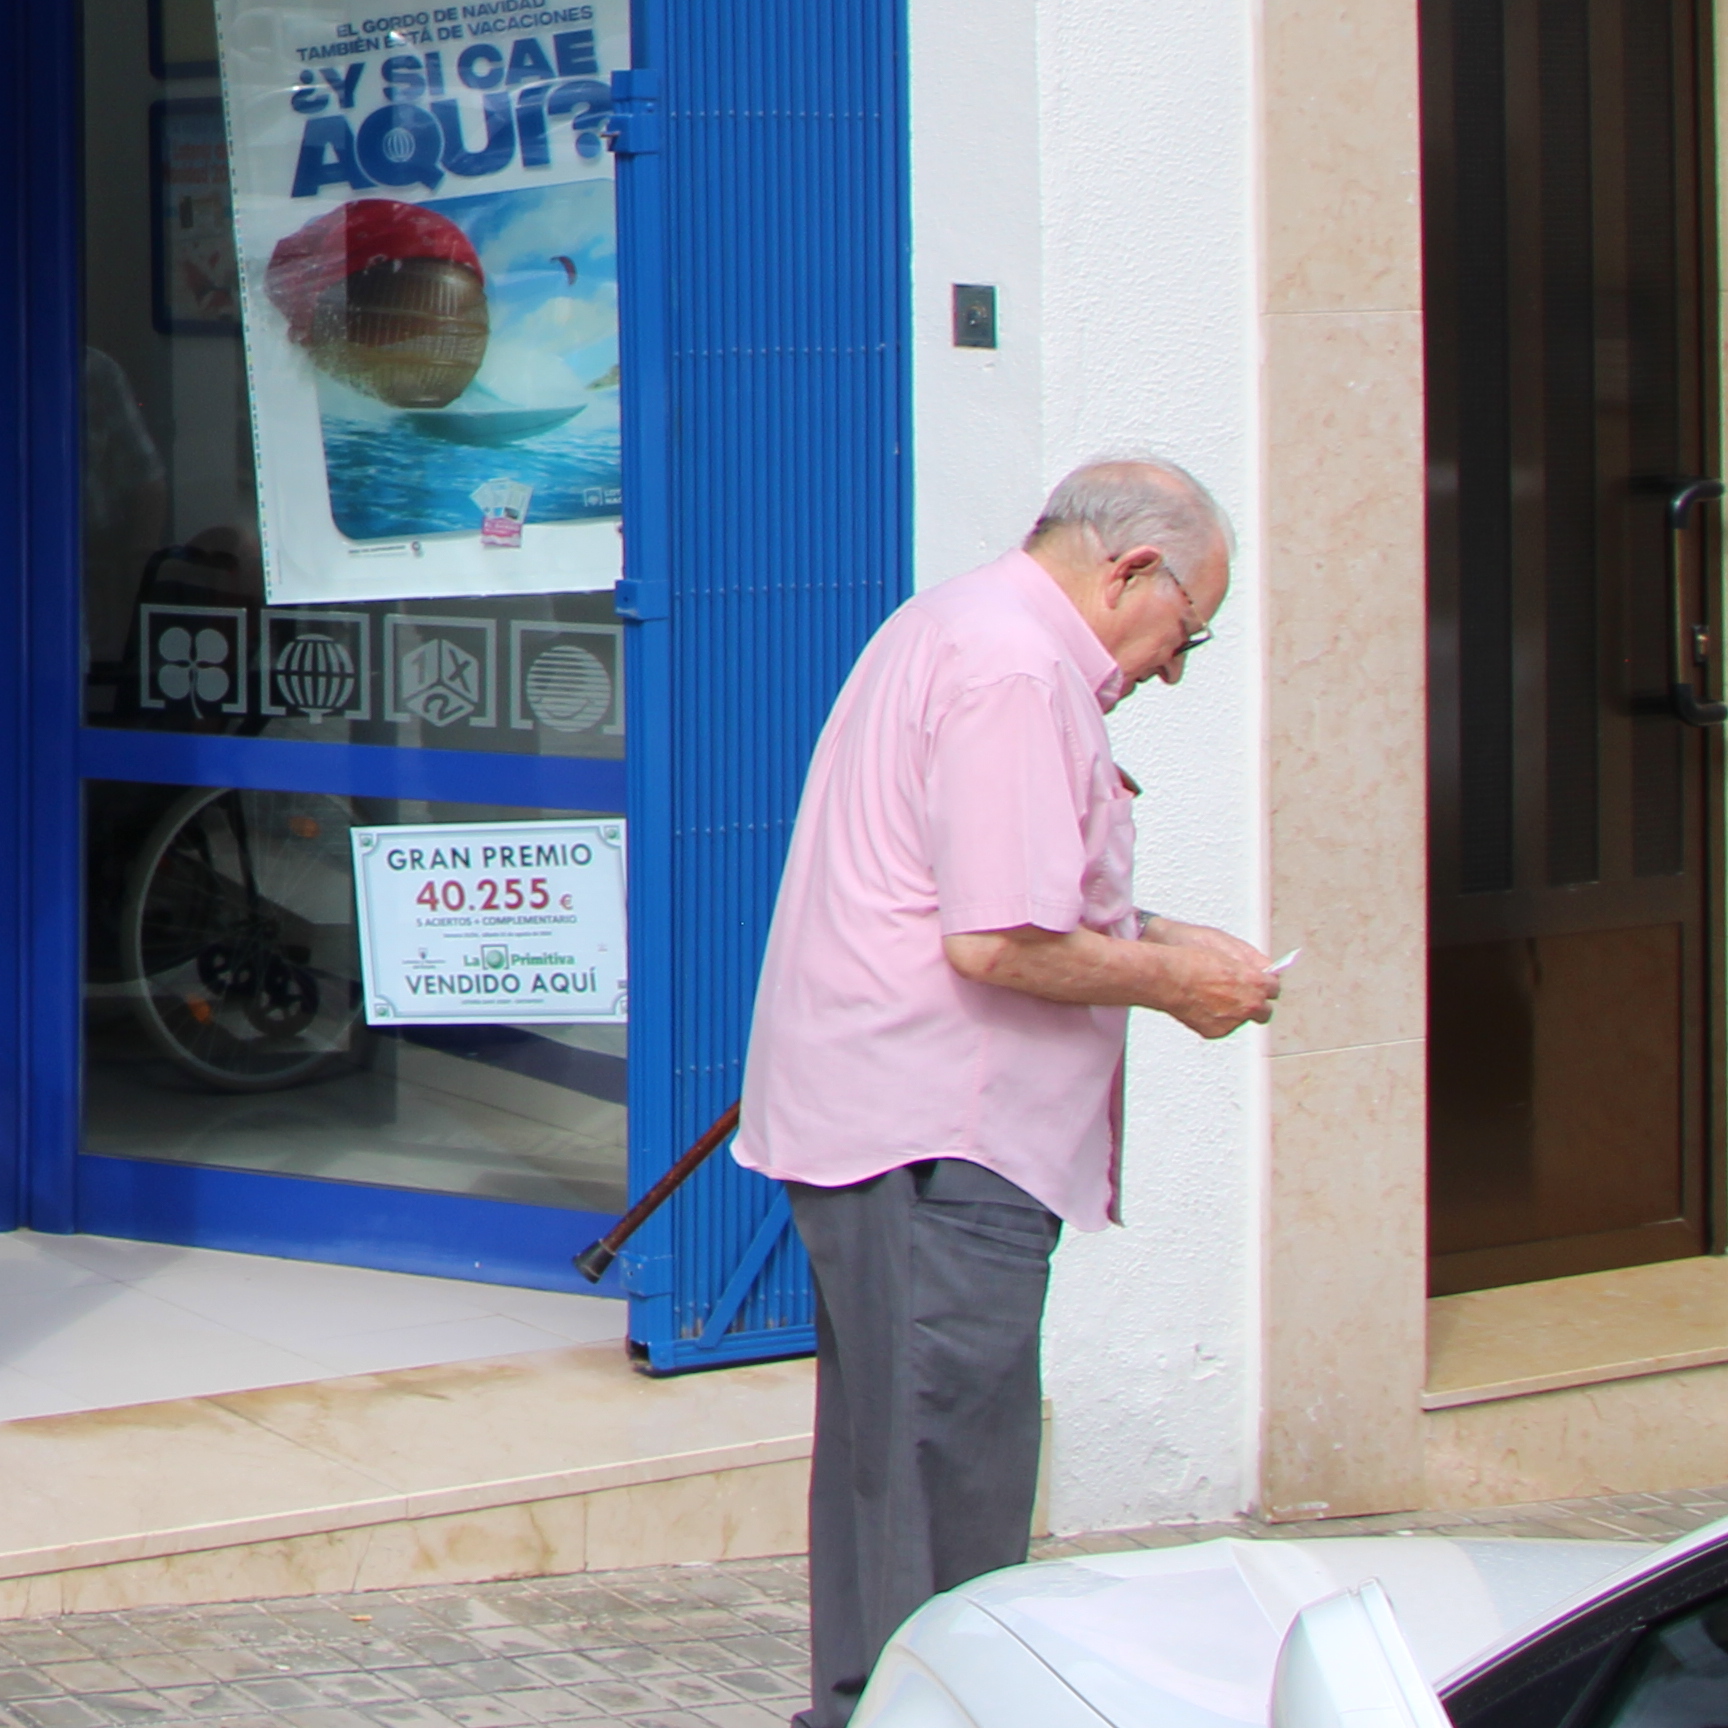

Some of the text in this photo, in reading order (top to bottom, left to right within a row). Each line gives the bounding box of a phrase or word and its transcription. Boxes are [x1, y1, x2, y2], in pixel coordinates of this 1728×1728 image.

[296, 35, 378, 62] TAMBIÉN
[439, 23, 463, 42] DE
[469, 5, 593, 37] VACACIONES
[337, 22, 359, 39] EL
[363, 11, 428, 33] GORDO
[434, 8, 459, 24] DE
[381, 51, 444, 103] SI
[457, 29, 599, 90] CAE
[387, 843, 592, 871] GRAN PREMIO
[416, 878, 573, 912] 40.255 €
[463, 953, 575, 967] La Primitiva
[405, 967, 596, 995] VENDIDO AQUÍ
